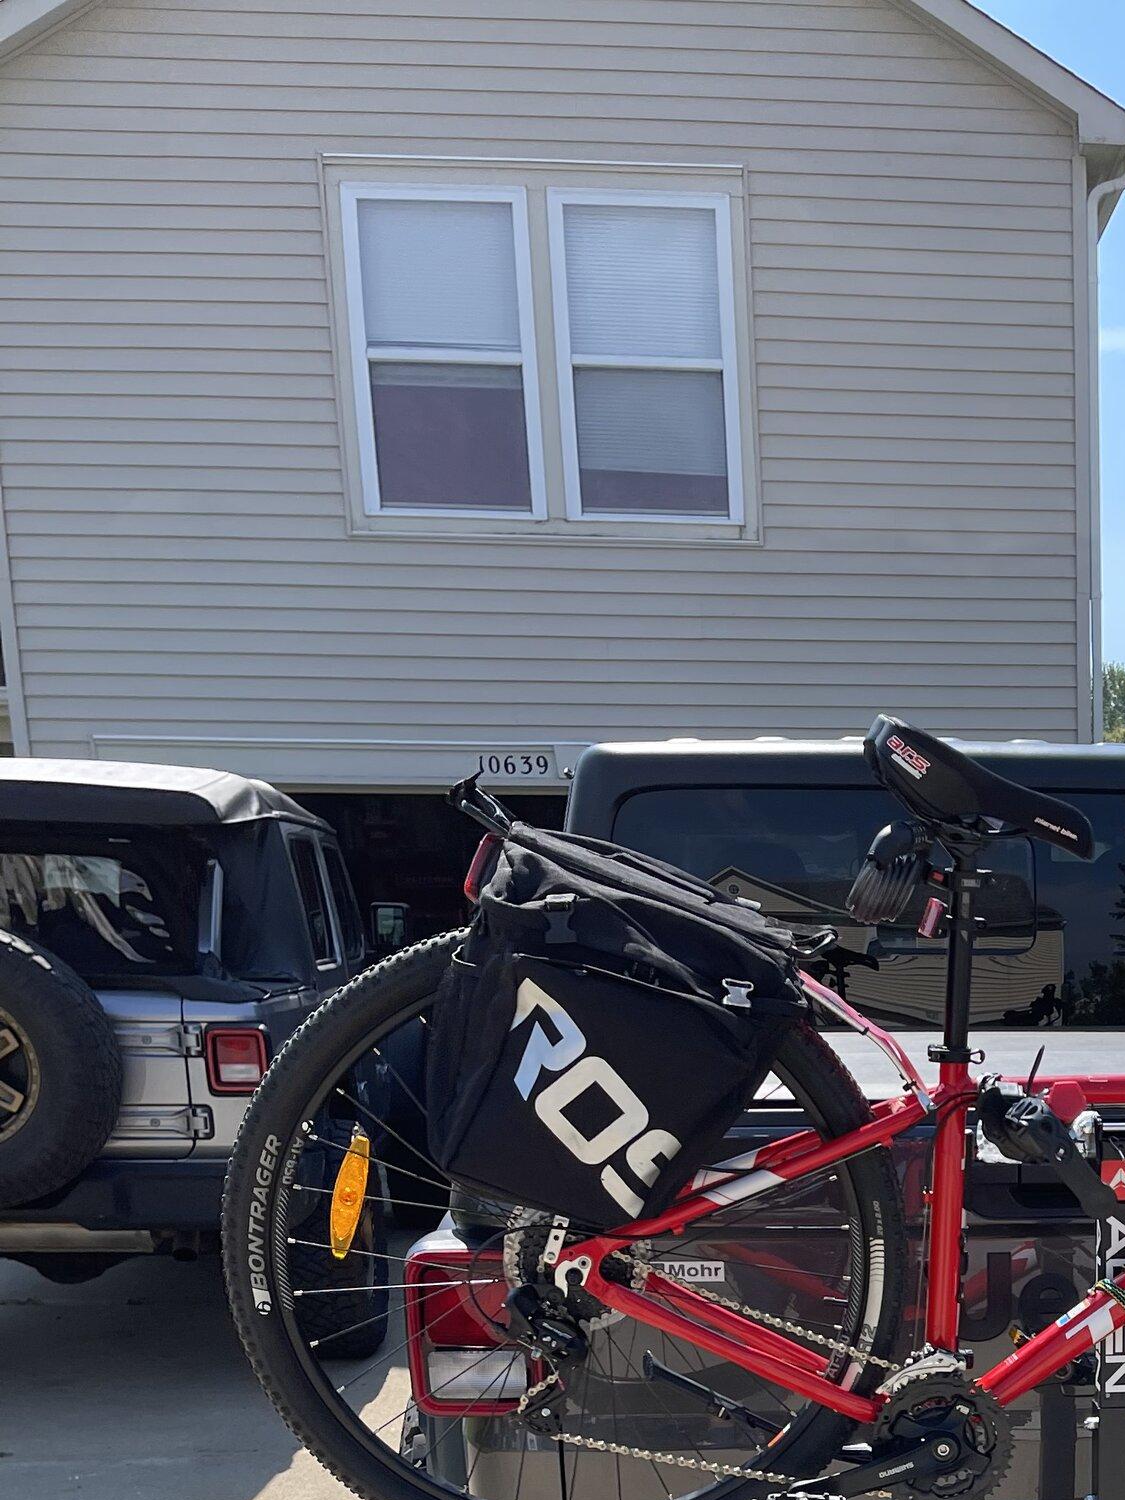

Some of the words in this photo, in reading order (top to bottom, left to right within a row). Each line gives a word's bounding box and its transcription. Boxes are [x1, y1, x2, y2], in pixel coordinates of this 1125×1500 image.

[479, 755, 548, 775] 10639
[248, 1134, 282, 1290] BONTRAGER
[668, 1263, 722, 1277] Mohr
